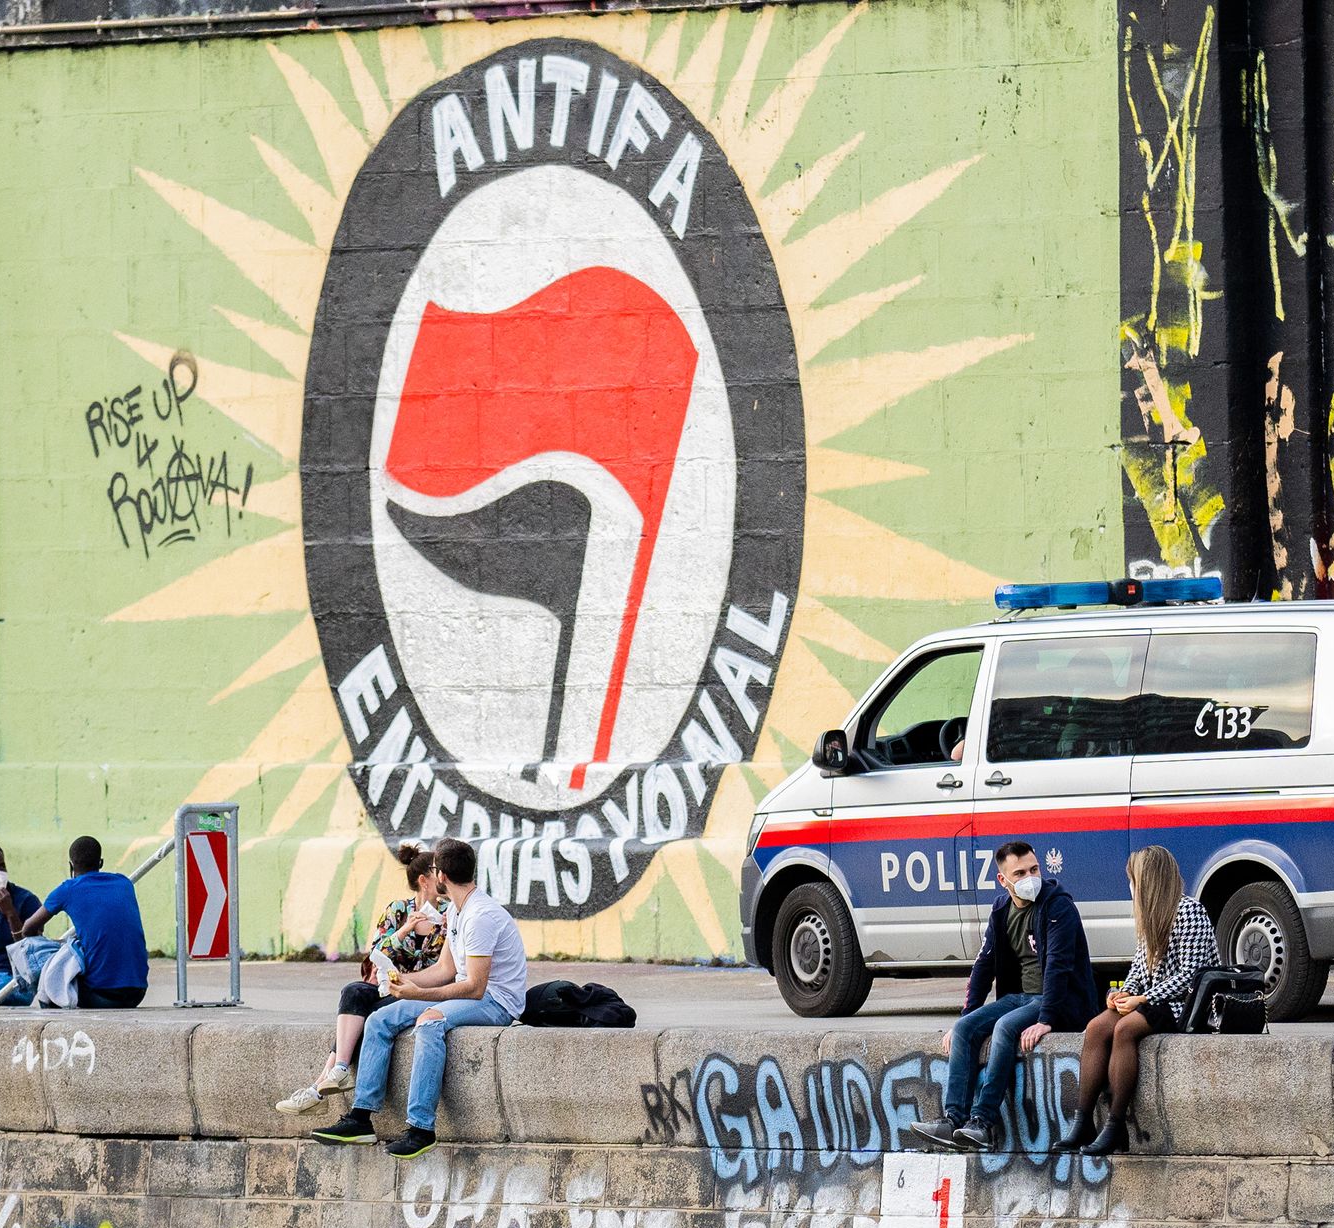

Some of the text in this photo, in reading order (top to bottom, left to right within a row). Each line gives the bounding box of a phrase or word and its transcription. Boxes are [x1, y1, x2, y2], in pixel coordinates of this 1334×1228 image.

[433, 54, 705, 240] ANTIFA
[153, 348, 198, 426] UP
[1212, 706, 1252, 740] 133
